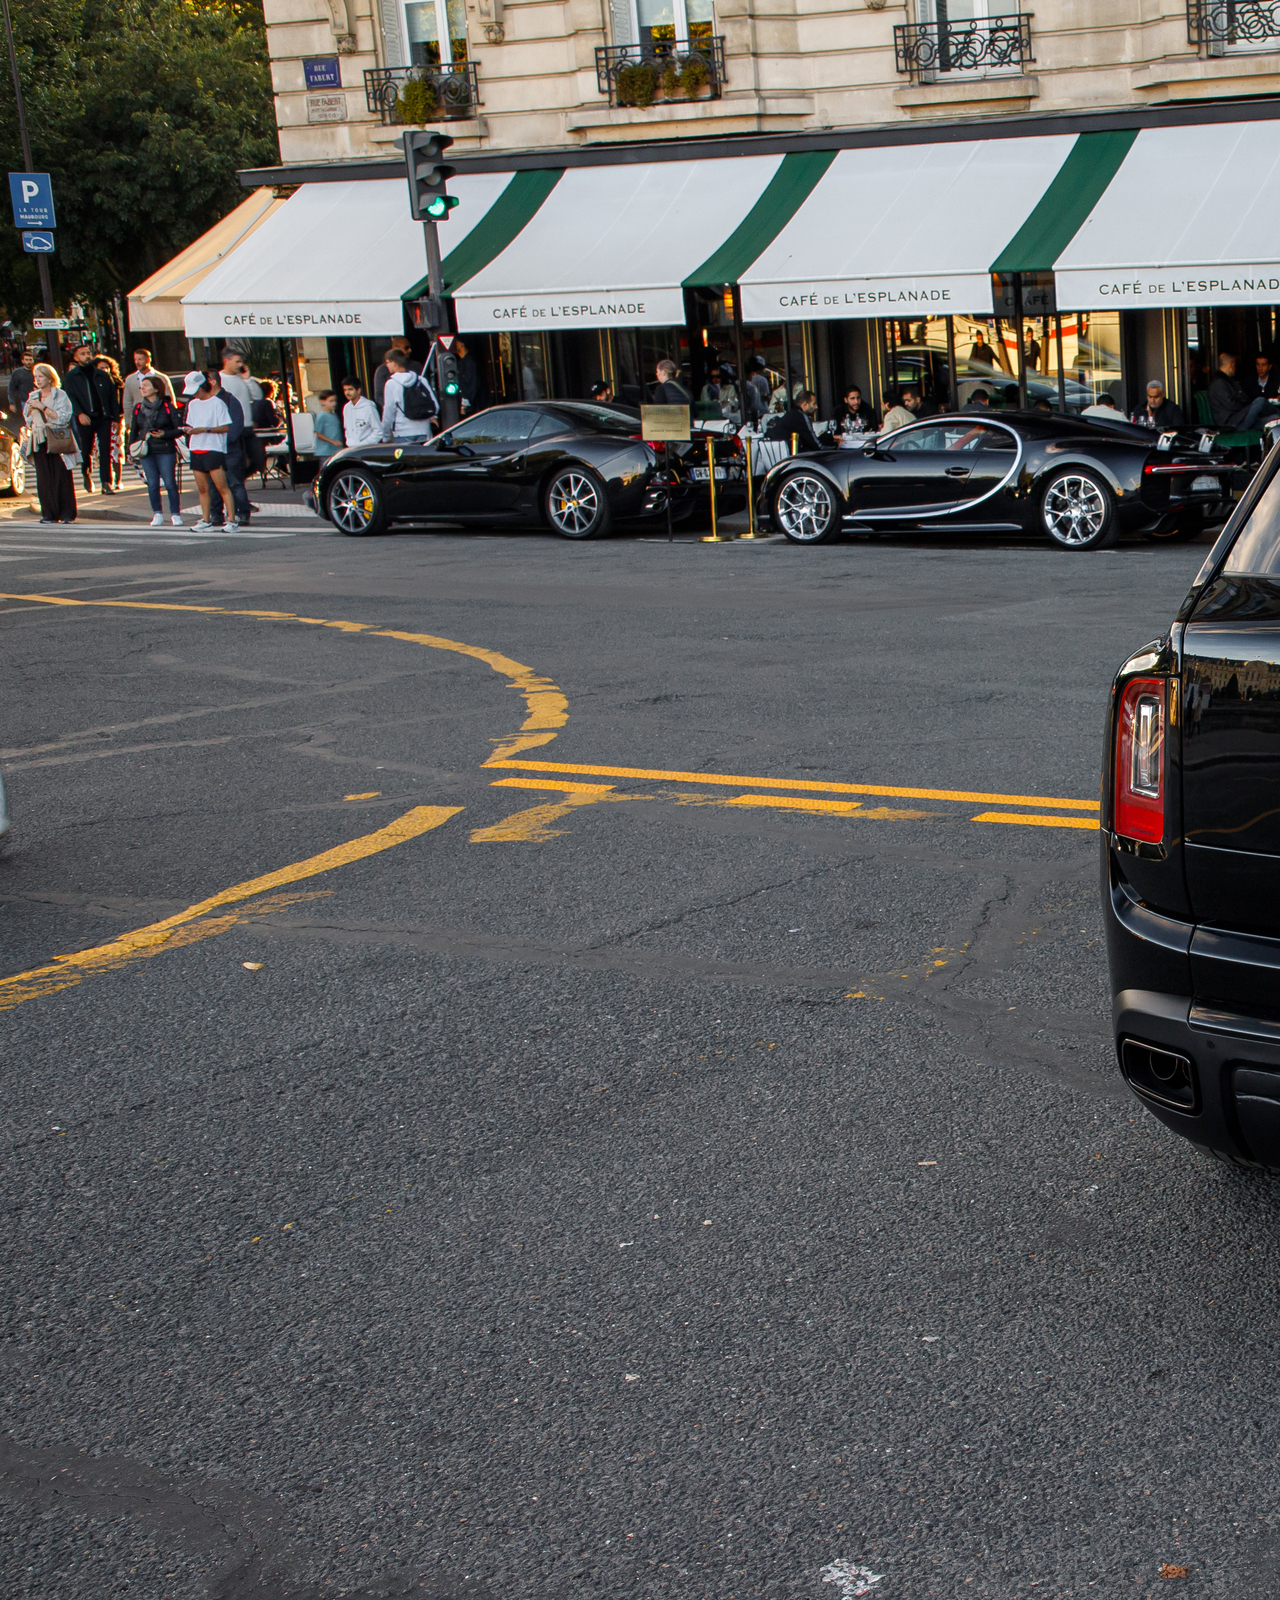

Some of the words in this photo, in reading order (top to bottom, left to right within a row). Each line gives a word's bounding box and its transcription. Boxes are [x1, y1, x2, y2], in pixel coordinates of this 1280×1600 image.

[313, 64, 327, 72] RUE
[309, 73, 335, 82] FABERT
[21, 180, 40, 204] P
[1099, 280, 1143, 295] CAFÉ
[1148, 284, 1166, 294] DE
[779, 292, 819, 307] CAFÉ
[823, 296, 840, 305] DE
[844, 289, 951, 304] L'ESPLANADE
[224, 312, 257, 325] CAFÉ
[259, 316, 273, 325] DE
[276, 313, 362, 325] L'ESPLANADE
[492, 305, 528, 319] CAFÉ
[532, 308, 547, 318] DE
[550, 303, 646, 317] L'ESPLANADE
